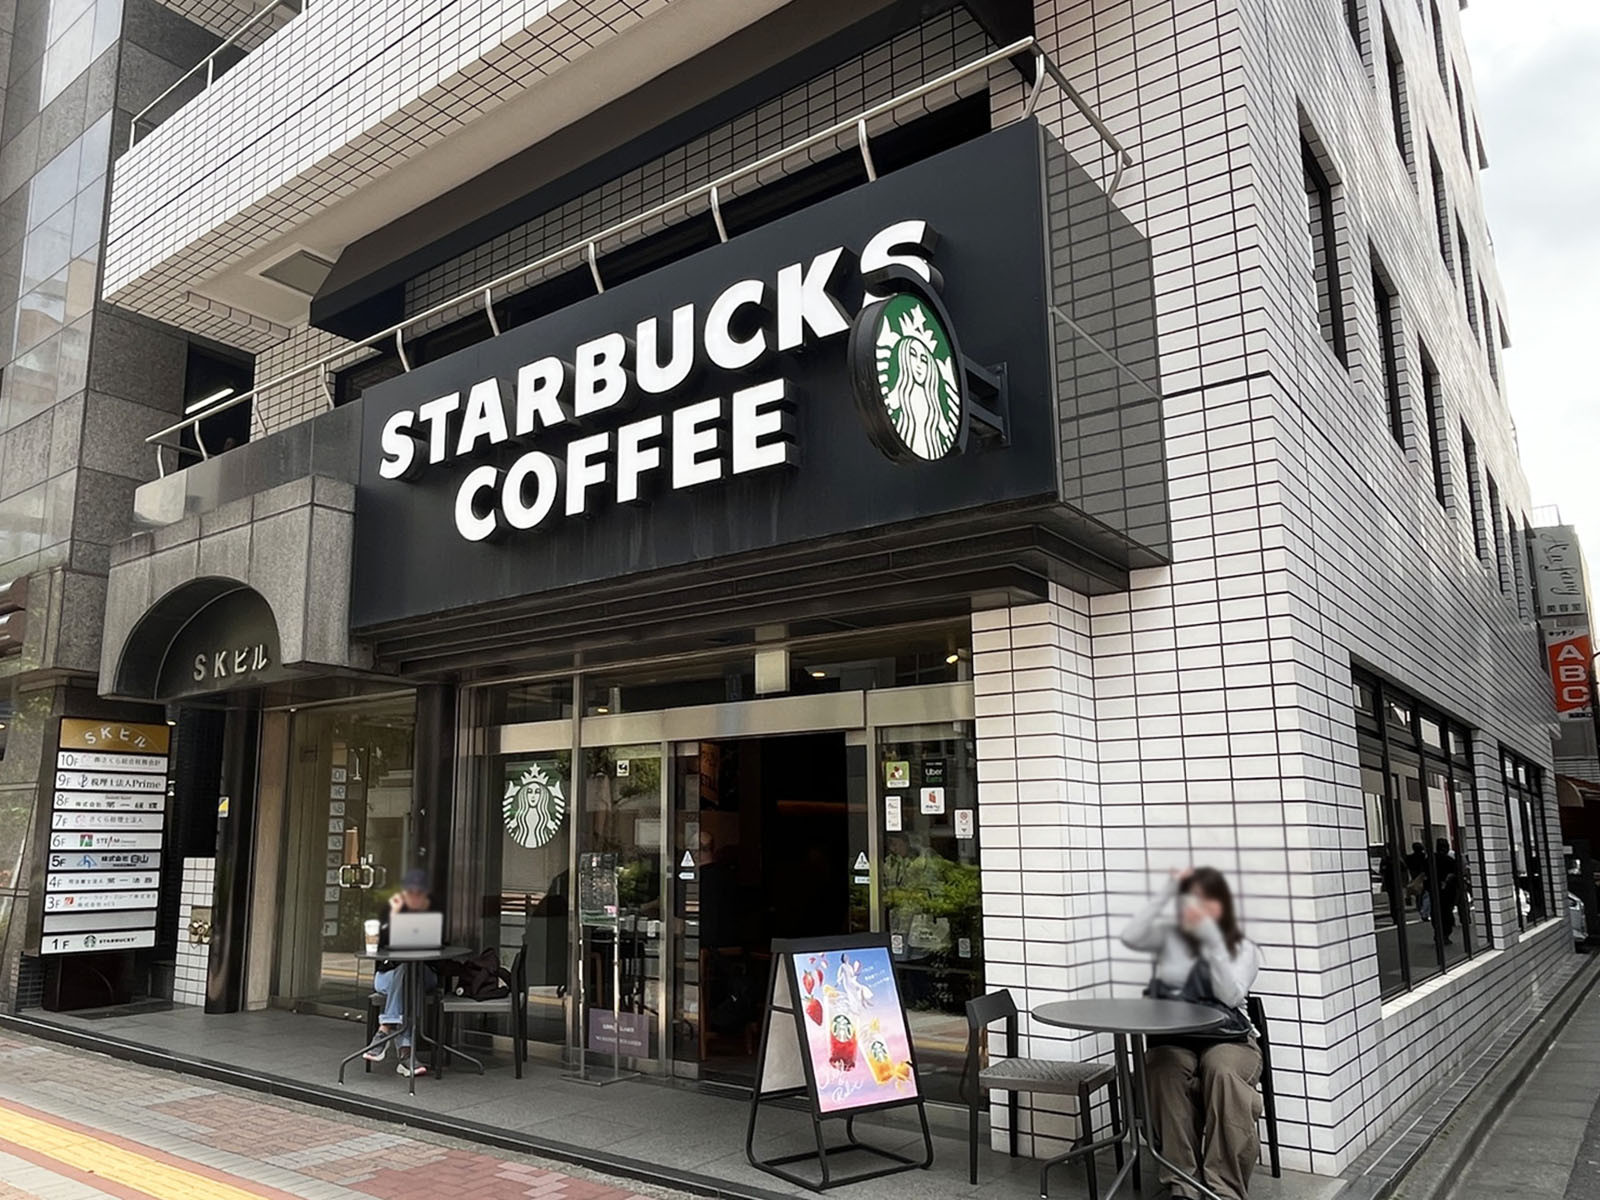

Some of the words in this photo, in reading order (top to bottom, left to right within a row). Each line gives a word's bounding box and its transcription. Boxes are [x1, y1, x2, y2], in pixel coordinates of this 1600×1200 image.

[454, 379, 786, 542] COFFEE
[1557, 644, 1590, 703] ABC
[61, 754, 78, 767] 10F
[925, 768, 943, 776] Uber
[58, 774, 71, 786] 9F
[56, 793, 70, 807] 8F
[55, 814, 68, 827] 7F
[52, 834, 66, 847] 6F
[51, 855, 66, 867] 5F
[49, 876, 62, 888] 4F
[47, 896, 60, 909] 3F
[52, 938, 70, 950] 1F
